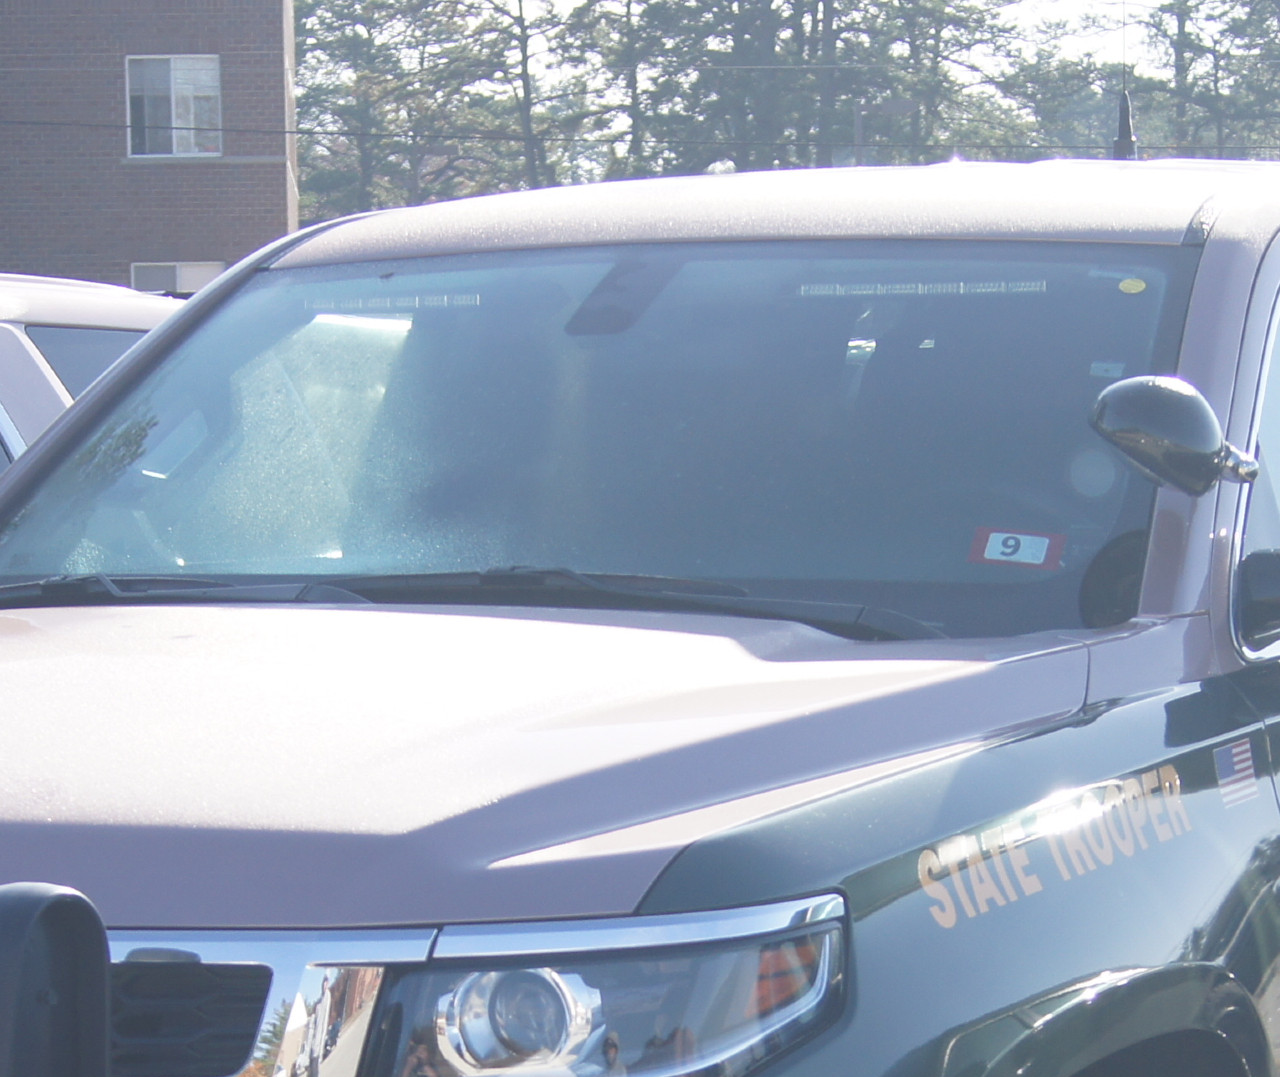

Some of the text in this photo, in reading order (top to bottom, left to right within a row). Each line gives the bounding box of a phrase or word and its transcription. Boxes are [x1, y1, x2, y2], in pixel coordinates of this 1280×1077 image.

[999, 535, 1022, 557] 9
[917, 764, 1193, 929] STATE TROOPER
